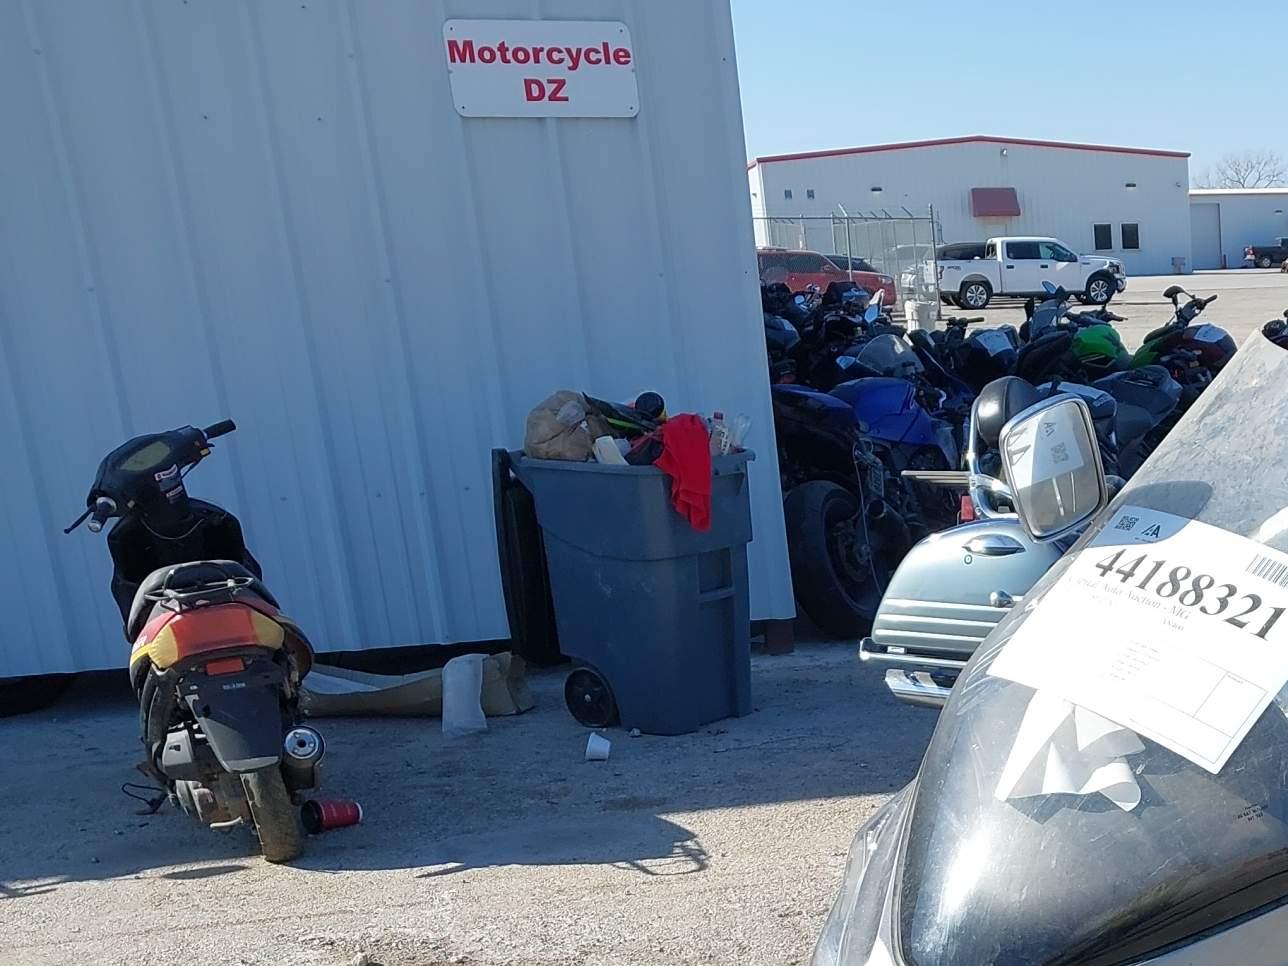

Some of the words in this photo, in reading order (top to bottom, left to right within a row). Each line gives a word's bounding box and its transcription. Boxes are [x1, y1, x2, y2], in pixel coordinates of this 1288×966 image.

[447, 39, 632, 71] Motorcycle
[523, 78, 569, 102] DZ
[1095, 548, 1287, 641] 44188321
